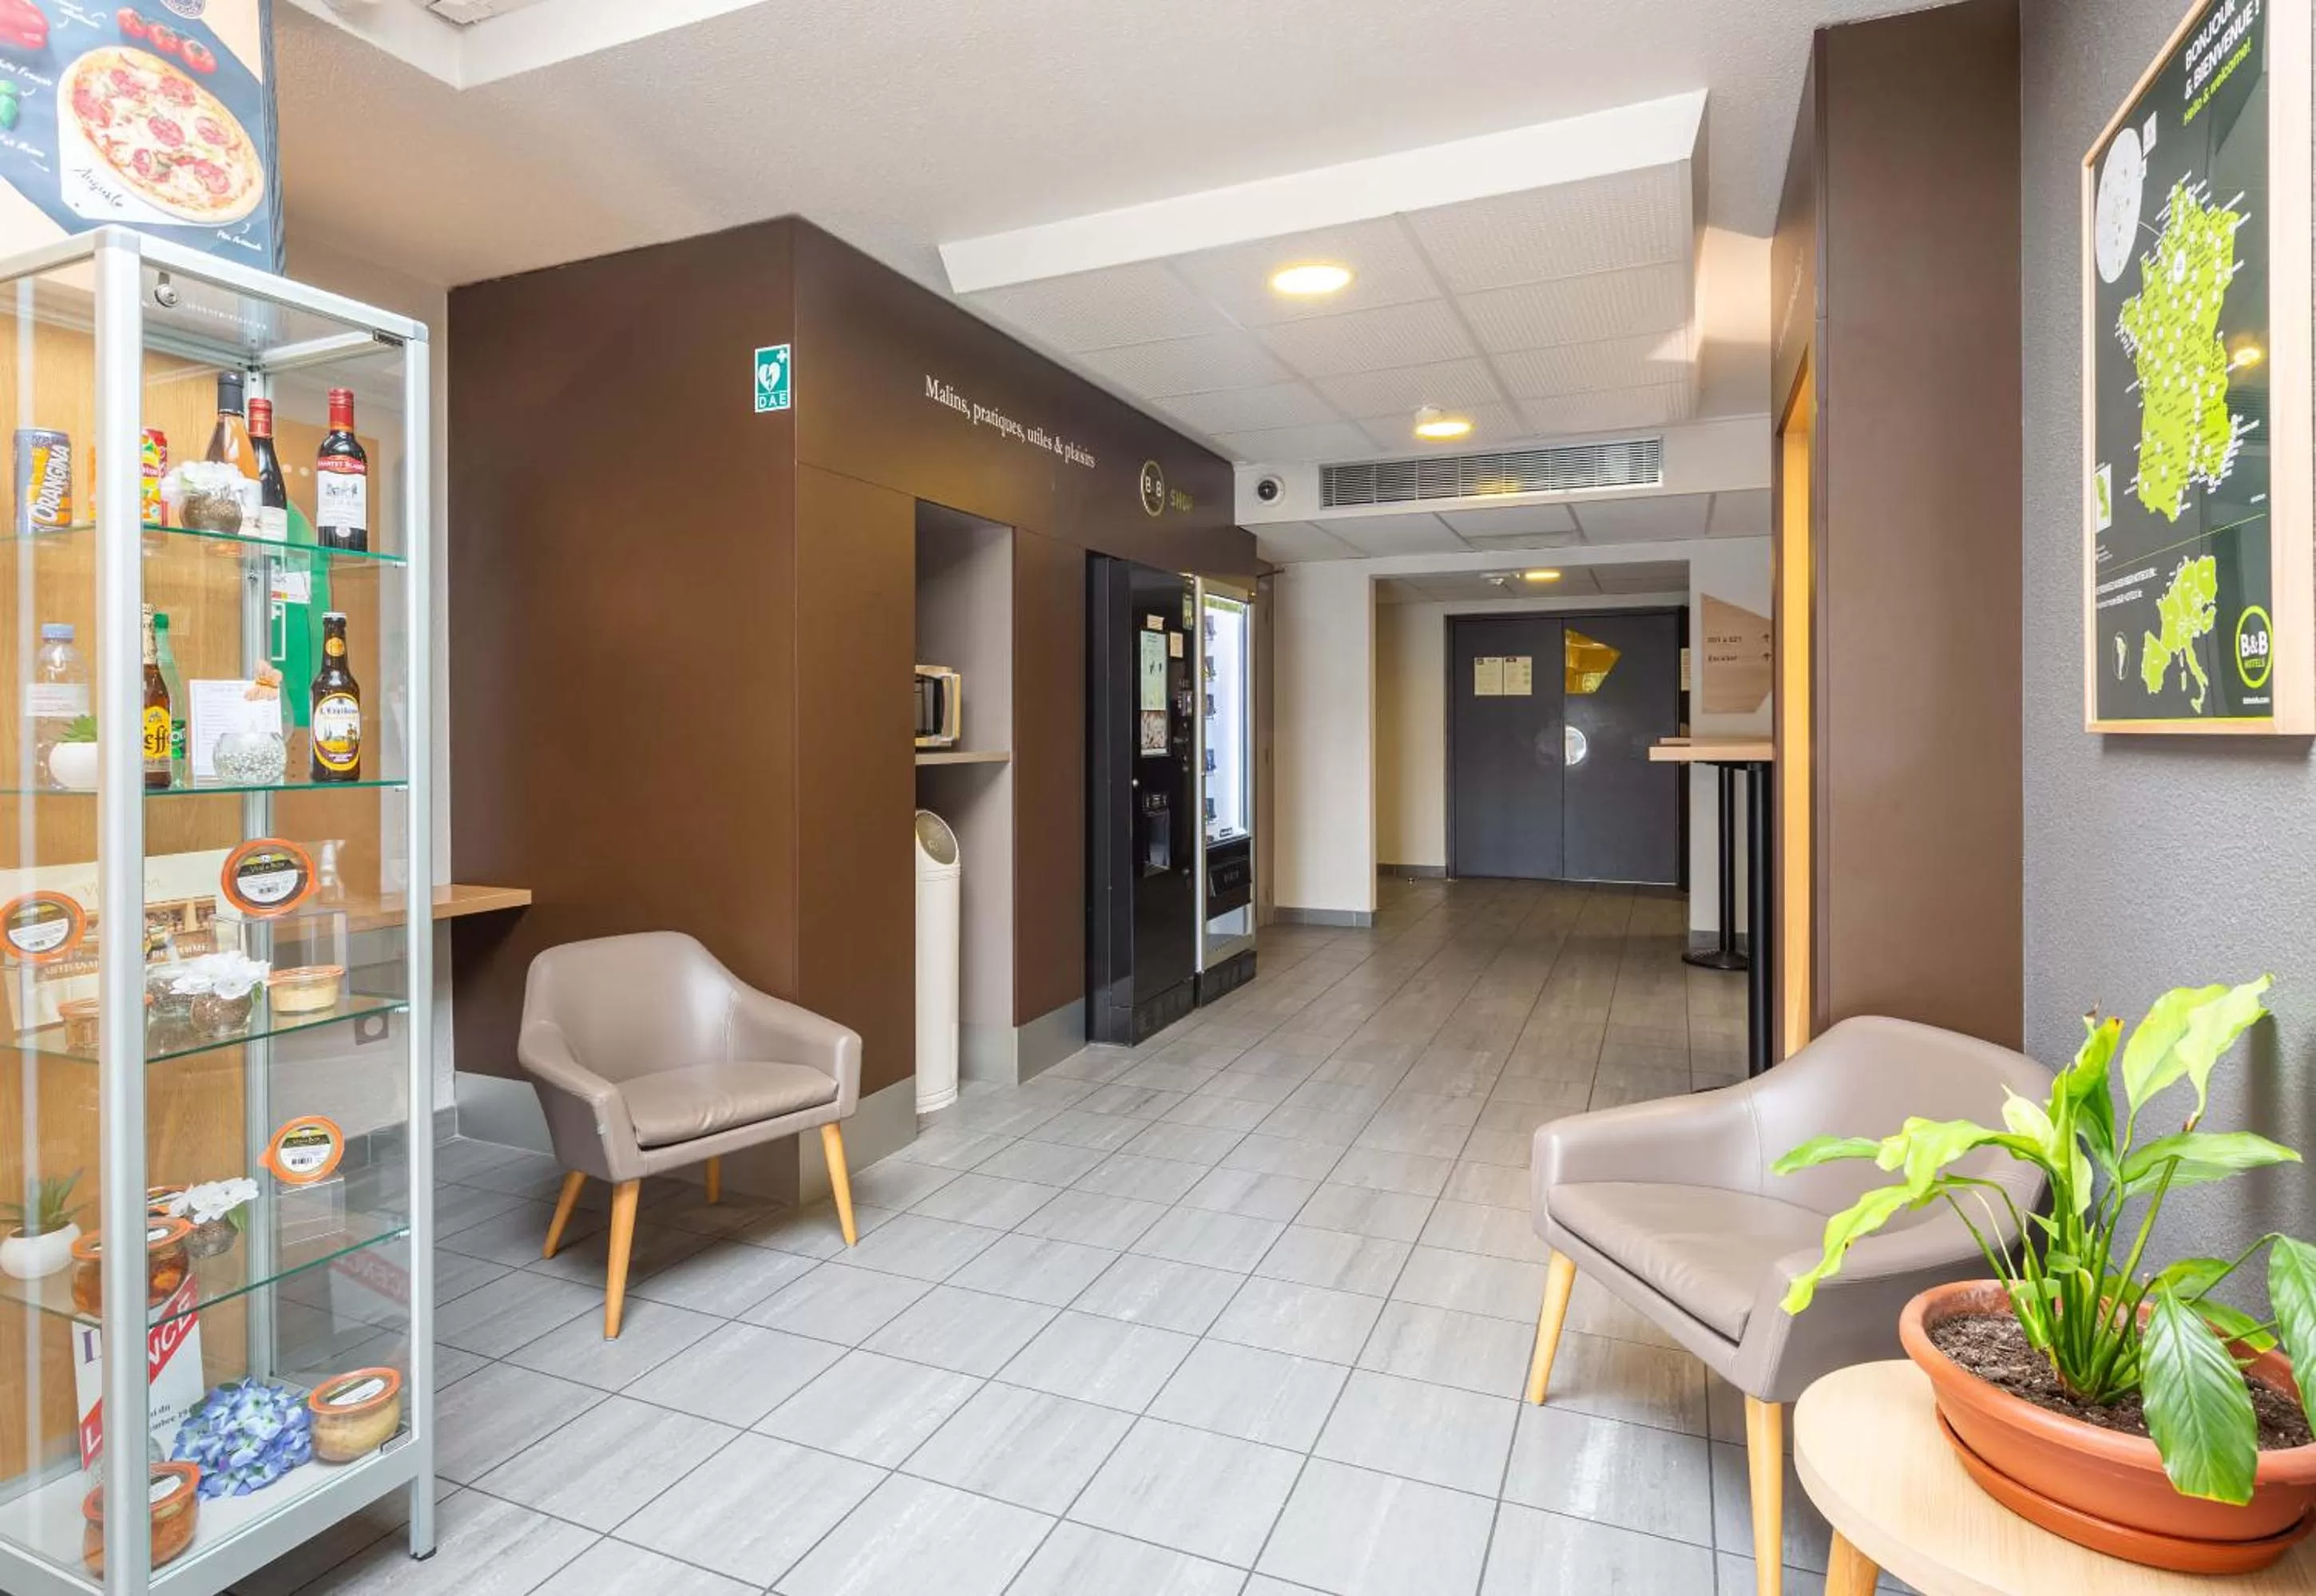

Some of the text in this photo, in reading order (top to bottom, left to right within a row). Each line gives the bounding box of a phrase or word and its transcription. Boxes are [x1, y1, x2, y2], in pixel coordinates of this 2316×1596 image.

[2185, 77, 2193, 100] &
[2194, 1, 2253, 89] BIENVENUE
[2186, 0, 2235, 71] BONJOUR
[759, 392, 787, 408] DAE
[926, 374, 1096, 469] Malins, pratiques, utiles & plaisirs
[32, 444, 69, 523] ORANGINA
[2240, 630, 2268, 657] B&B
[144, 724, 170, 754] eff
